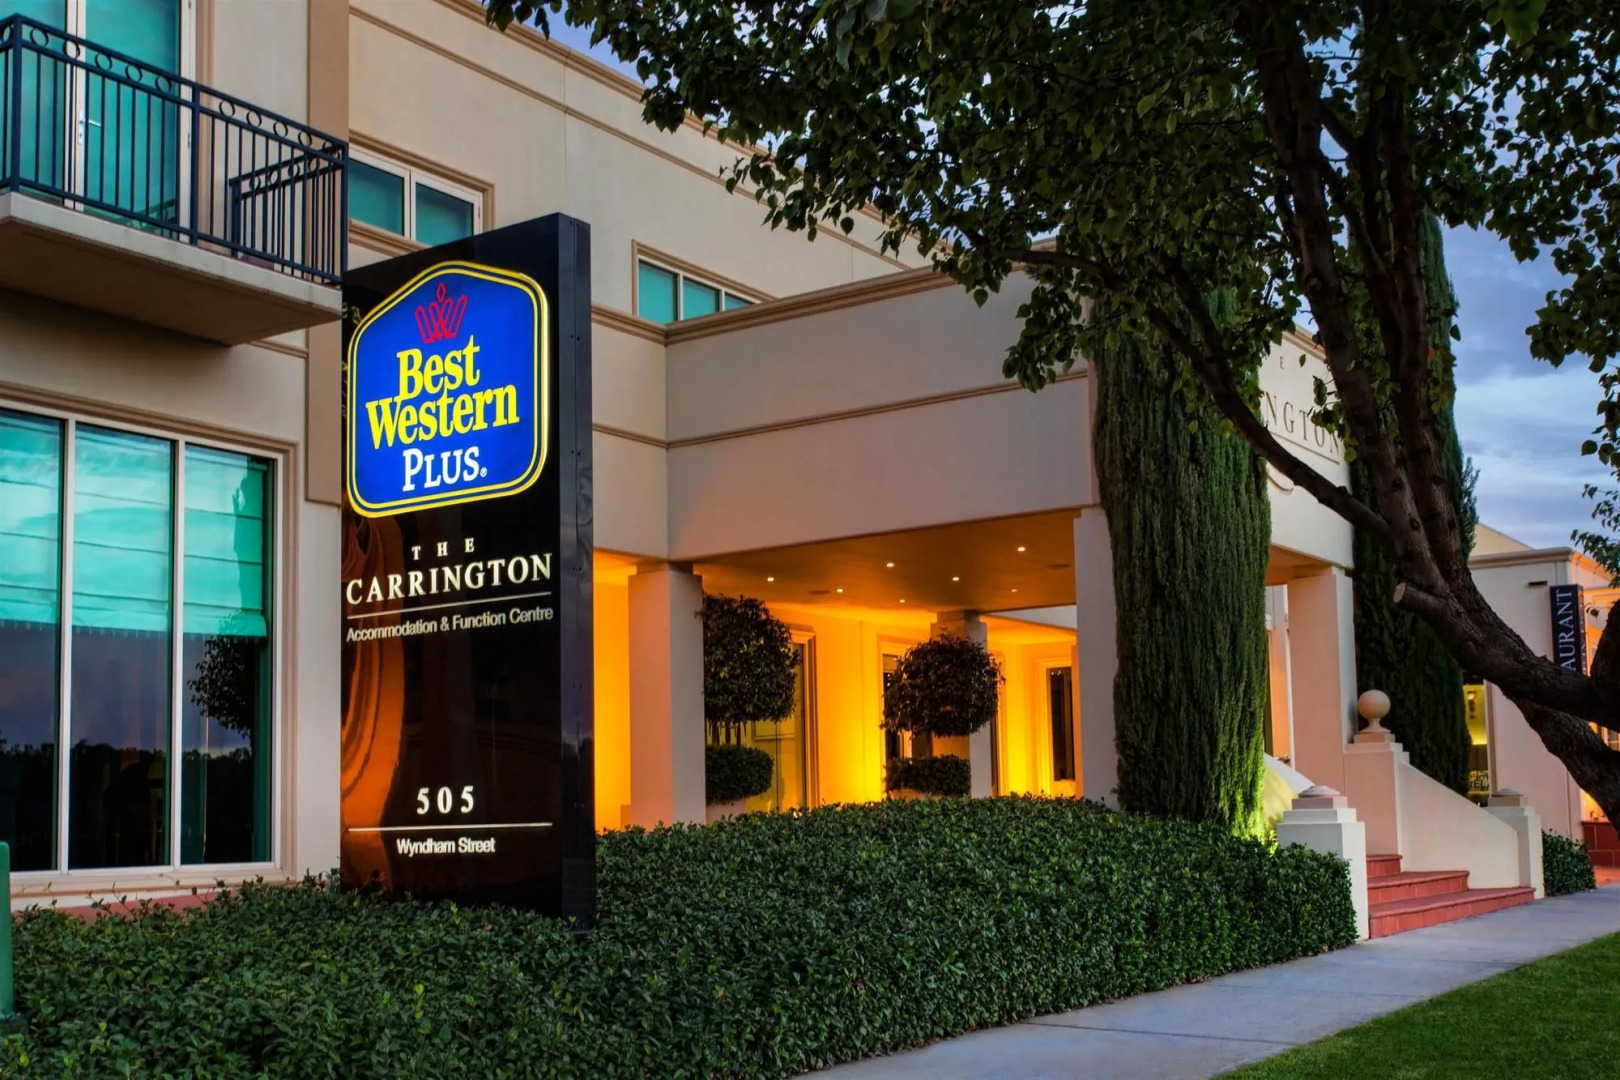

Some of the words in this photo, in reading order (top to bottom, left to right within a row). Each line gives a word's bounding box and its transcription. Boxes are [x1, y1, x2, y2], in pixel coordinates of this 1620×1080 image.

[396, 334, 480, 400] Best
[365, 384, 520, 450] Western
[411, 537, 475, 561] THE
[346, 553, 553, 605] CARRINGTON
[346, 618, 438, 643] Accommodation
[440, 616, 450, 632] &
[452, 609, 506, 631] Function
[509, 606, 554, 625] Centre
[416, 785, 474, 815] 505
[396, 837, 456, 858] Wyndham
[458, 836, 496, 853] Street
